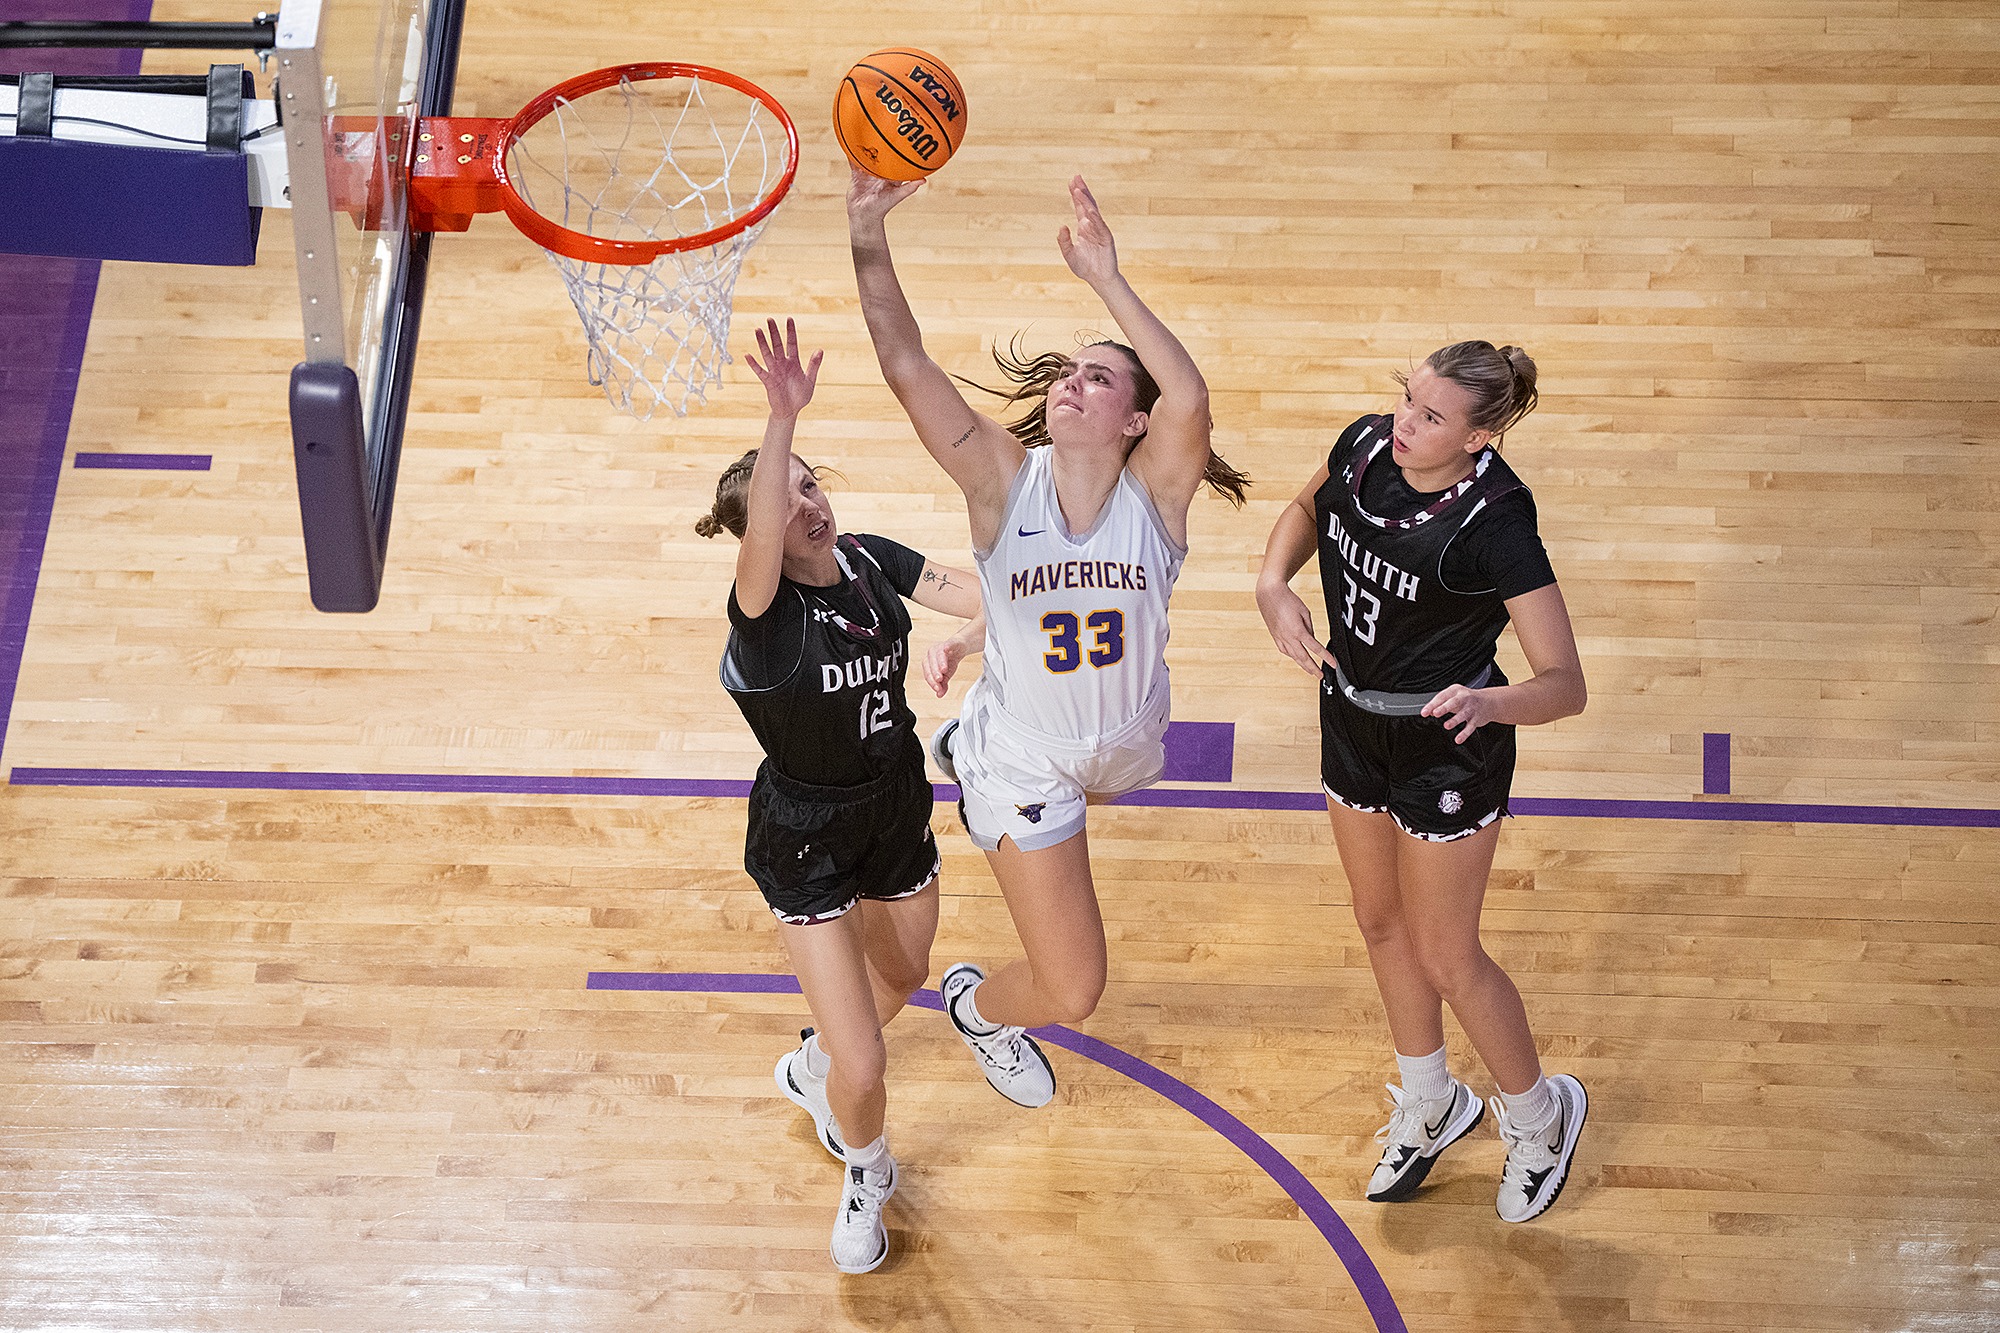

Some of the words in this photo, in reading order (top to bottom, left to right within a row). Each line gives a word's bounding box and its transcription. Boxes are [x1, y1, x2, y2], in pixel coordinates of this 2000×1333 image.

[875, 83, 939, 161] Wilson
[908, 65, 960, 122] NCAA
[952, 425, 976, 448] EMBRACE
[1010, 560, 1148, 601] MAVERICKS
[1326, 511, 1421, 602] DULUTH
[1341, 568, 1382, 646] 33
[1039, 607, 1126, 676] 33
[859, 688, 893, 741] 12
